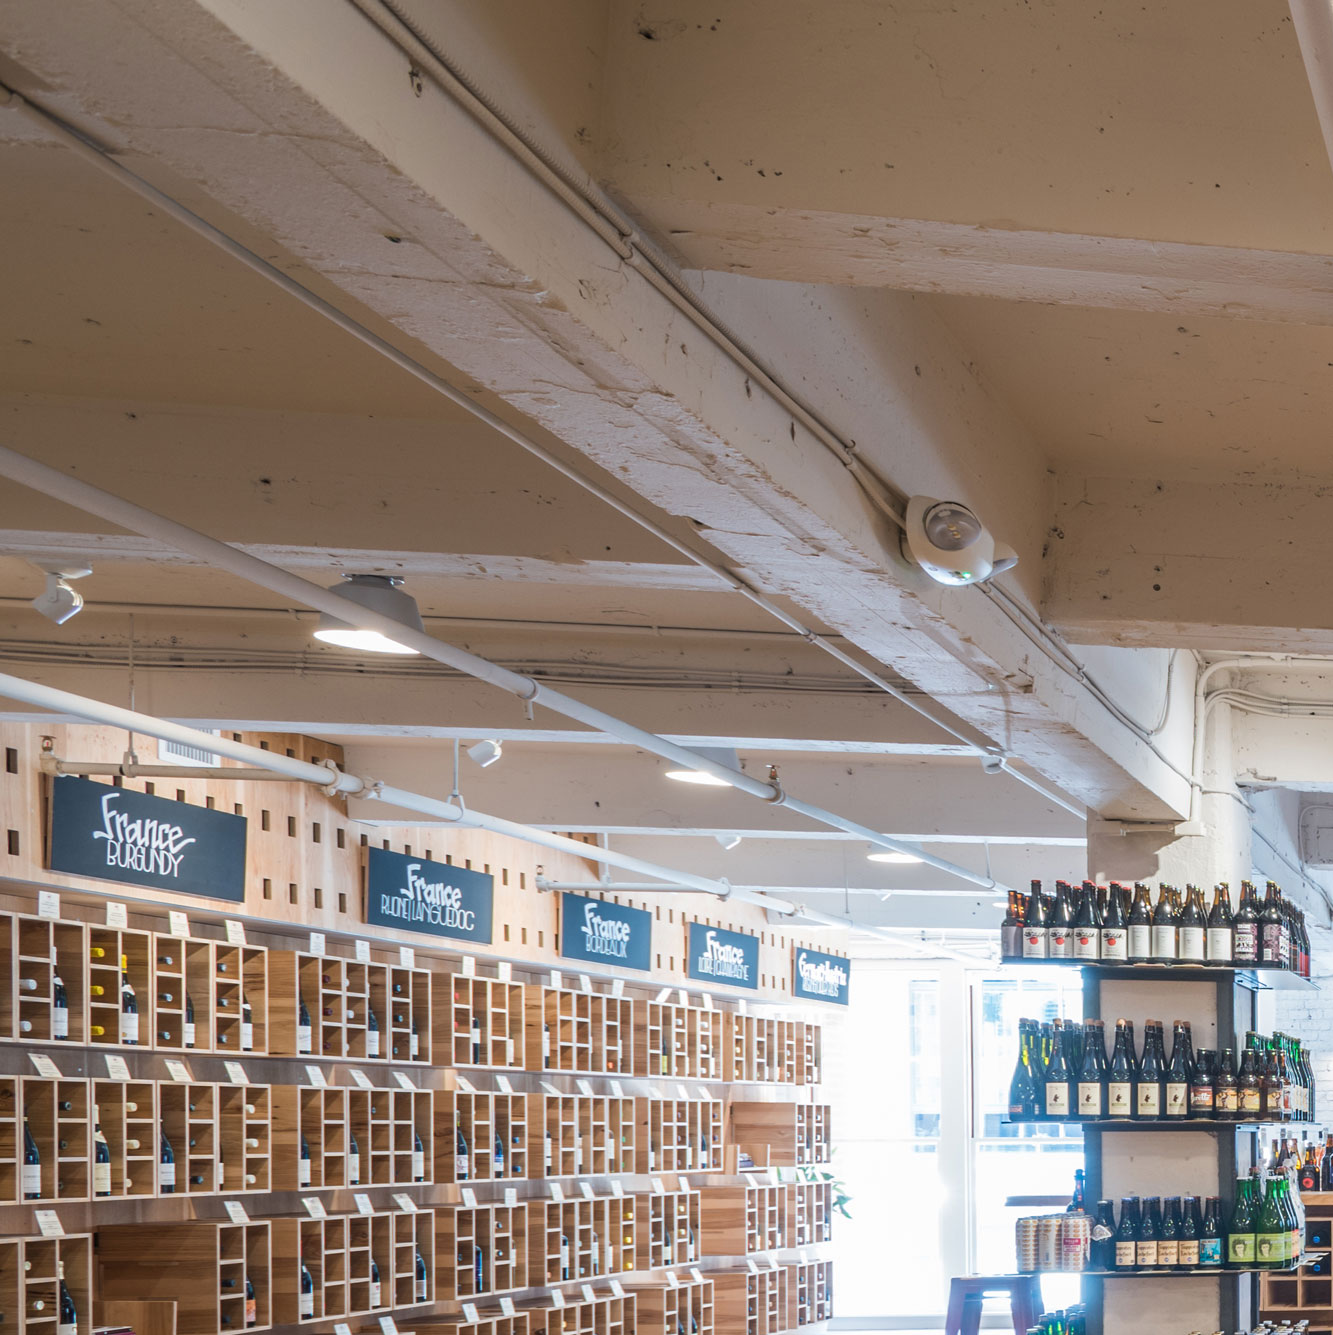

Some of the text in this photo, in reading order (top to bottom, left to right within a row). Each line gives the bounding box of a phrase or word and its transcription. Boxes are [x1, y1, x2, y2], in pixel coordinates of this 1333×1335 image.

[92, 793, 196, 854] France
[106, 840, 185, 878] BURGUNDY
[400, 863, 462, 909] France
[581, 902, 631, 942] France
[585, 934, 628, 958] BORDEAUX
[703, 930, 744, 964] France
